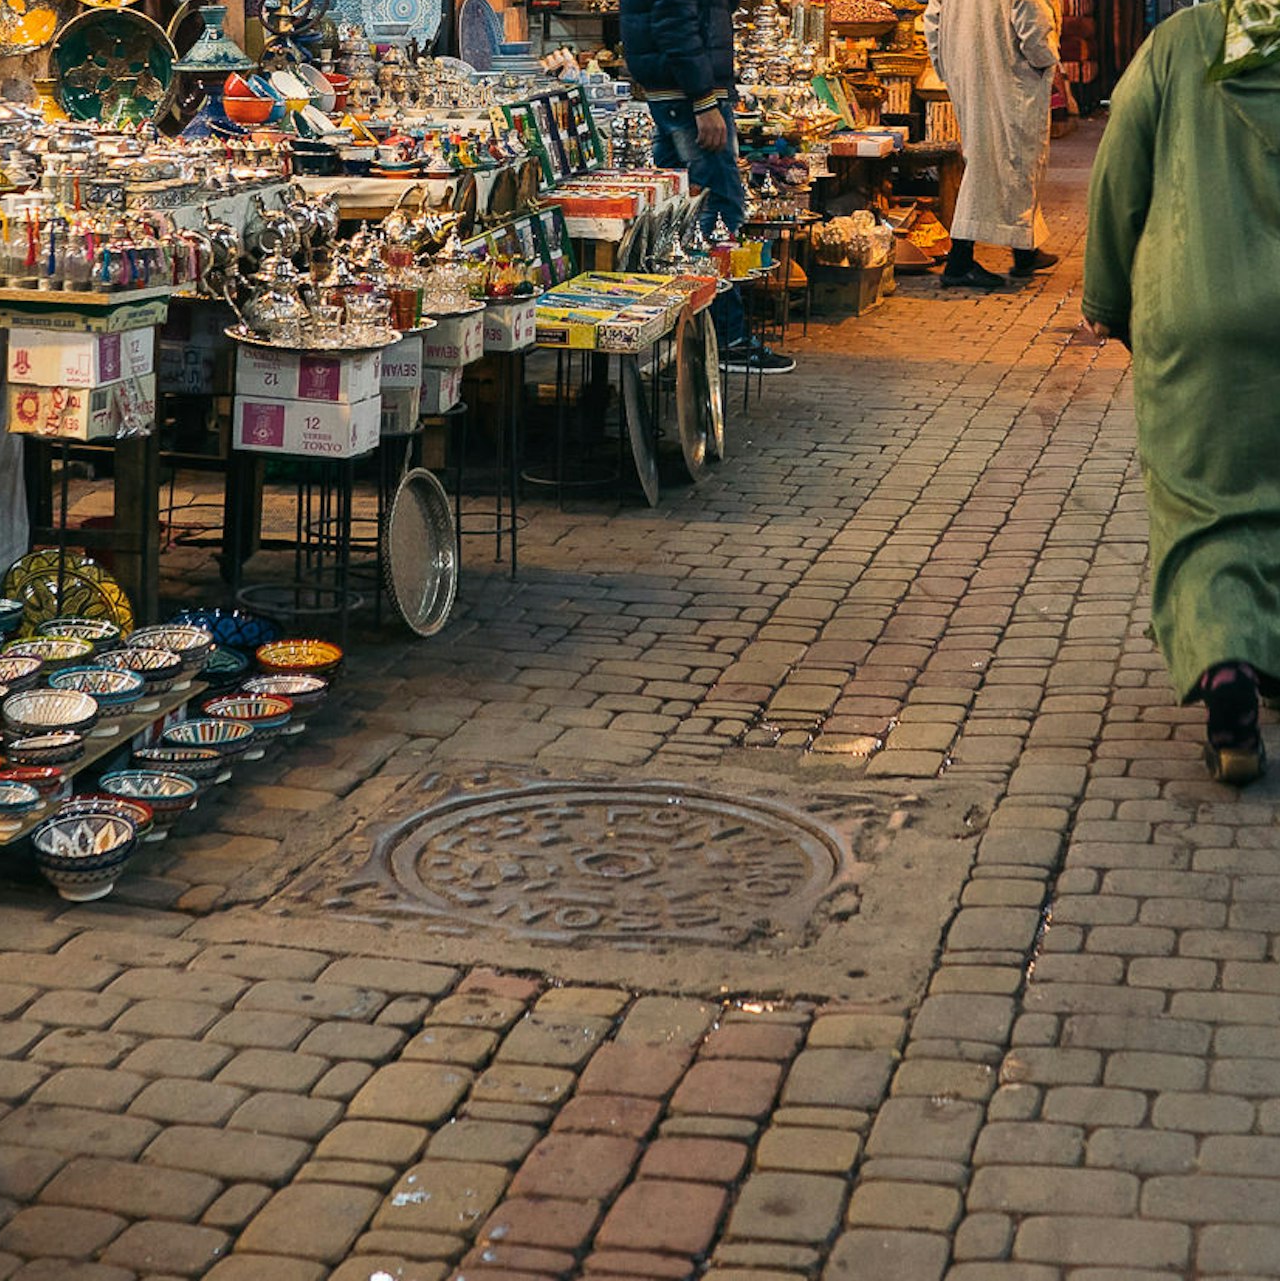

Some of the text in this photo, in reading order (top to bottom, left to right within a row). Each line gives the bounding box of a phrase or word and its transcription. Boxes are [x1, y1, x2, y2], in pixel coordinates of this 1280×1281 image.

[483, 328, 503, 341] SEV
[426, 345, 460, 359] SEVAM
[382, 363, 417, 377] SEVAM
[263, 372, 279, 386] 12
[304, 417, 320, 430] 12
[302, 441, 343, 452] TOKYO
